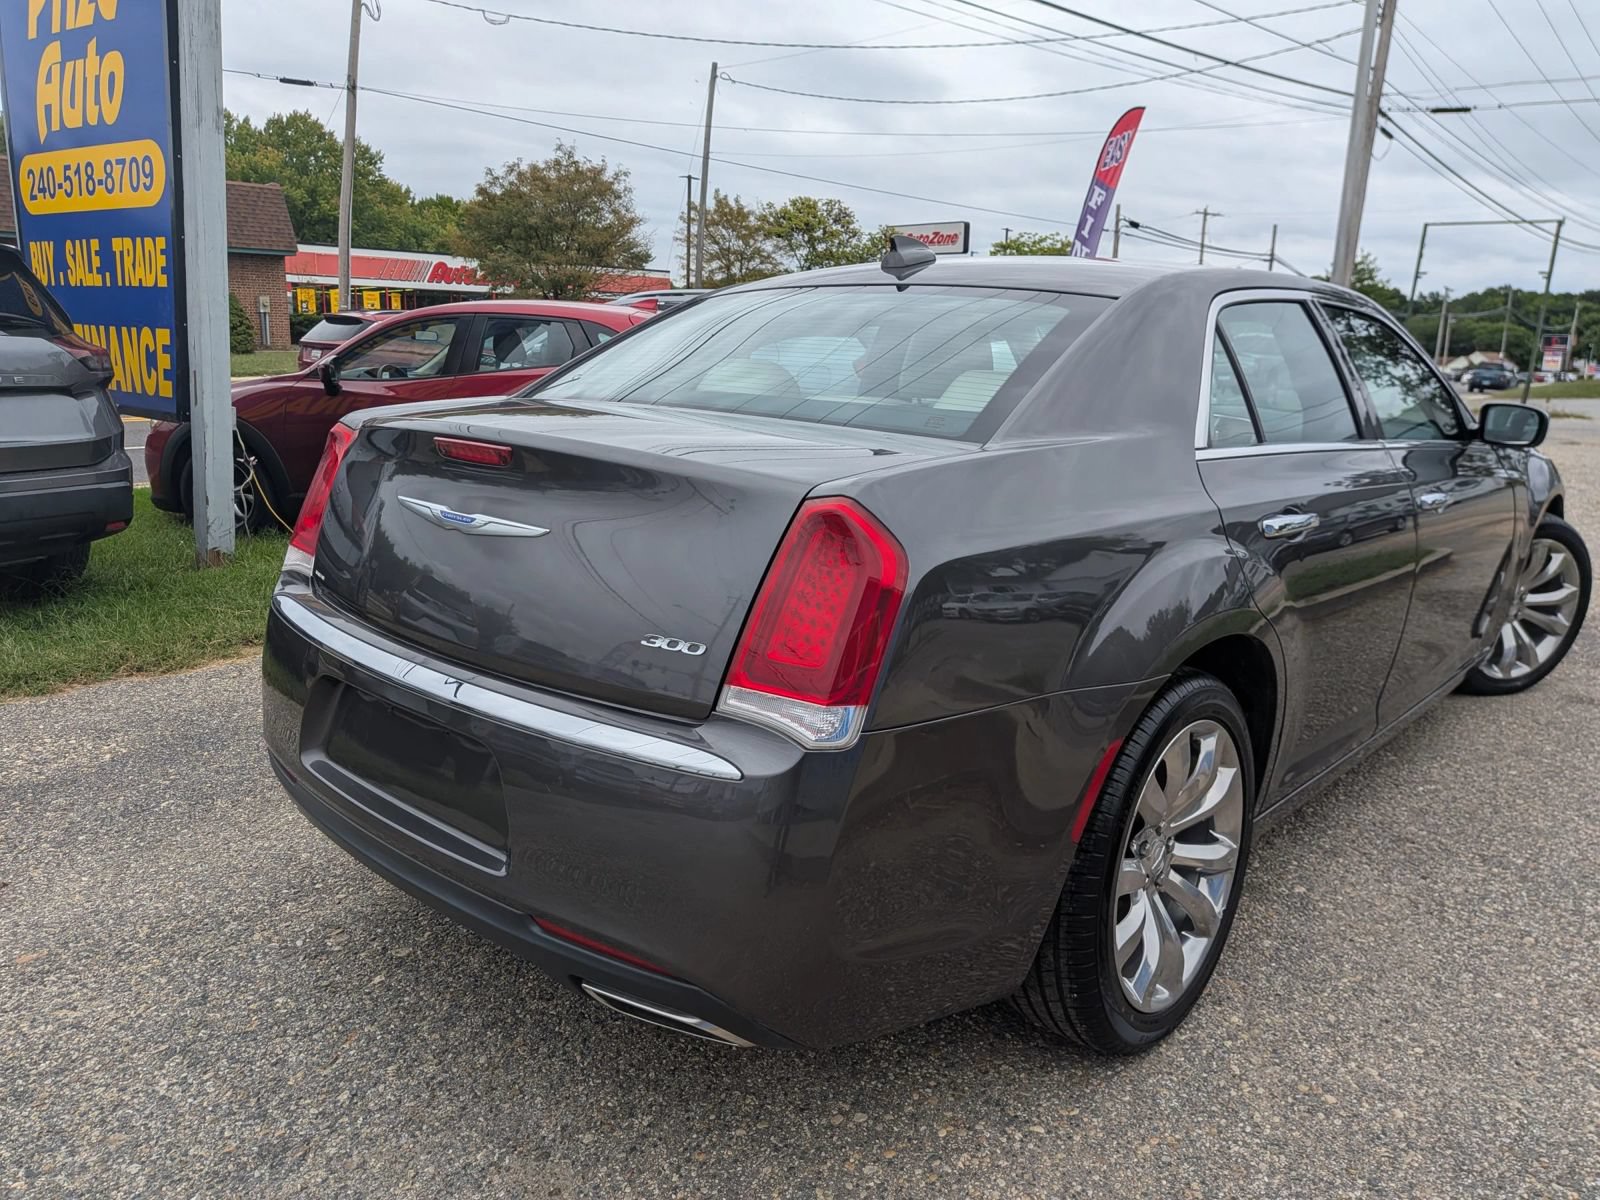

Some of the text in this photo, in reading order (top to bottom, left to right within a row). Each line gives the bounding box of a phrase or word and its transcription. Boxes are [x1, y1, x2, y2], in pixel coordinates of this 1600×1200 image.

[36, 36, 124, 144] Auto
[27, 155, 154, 201] 240-518-8709
[29, 240, 56, 286] BUY
[65, 238, 102, 287] SALE
[112, 236, 168, 287] TRADE
[907, 232, 959, 244] toZone
[73, 323, 173, 398] ANCE
[640, 633, 707, 656] 300
